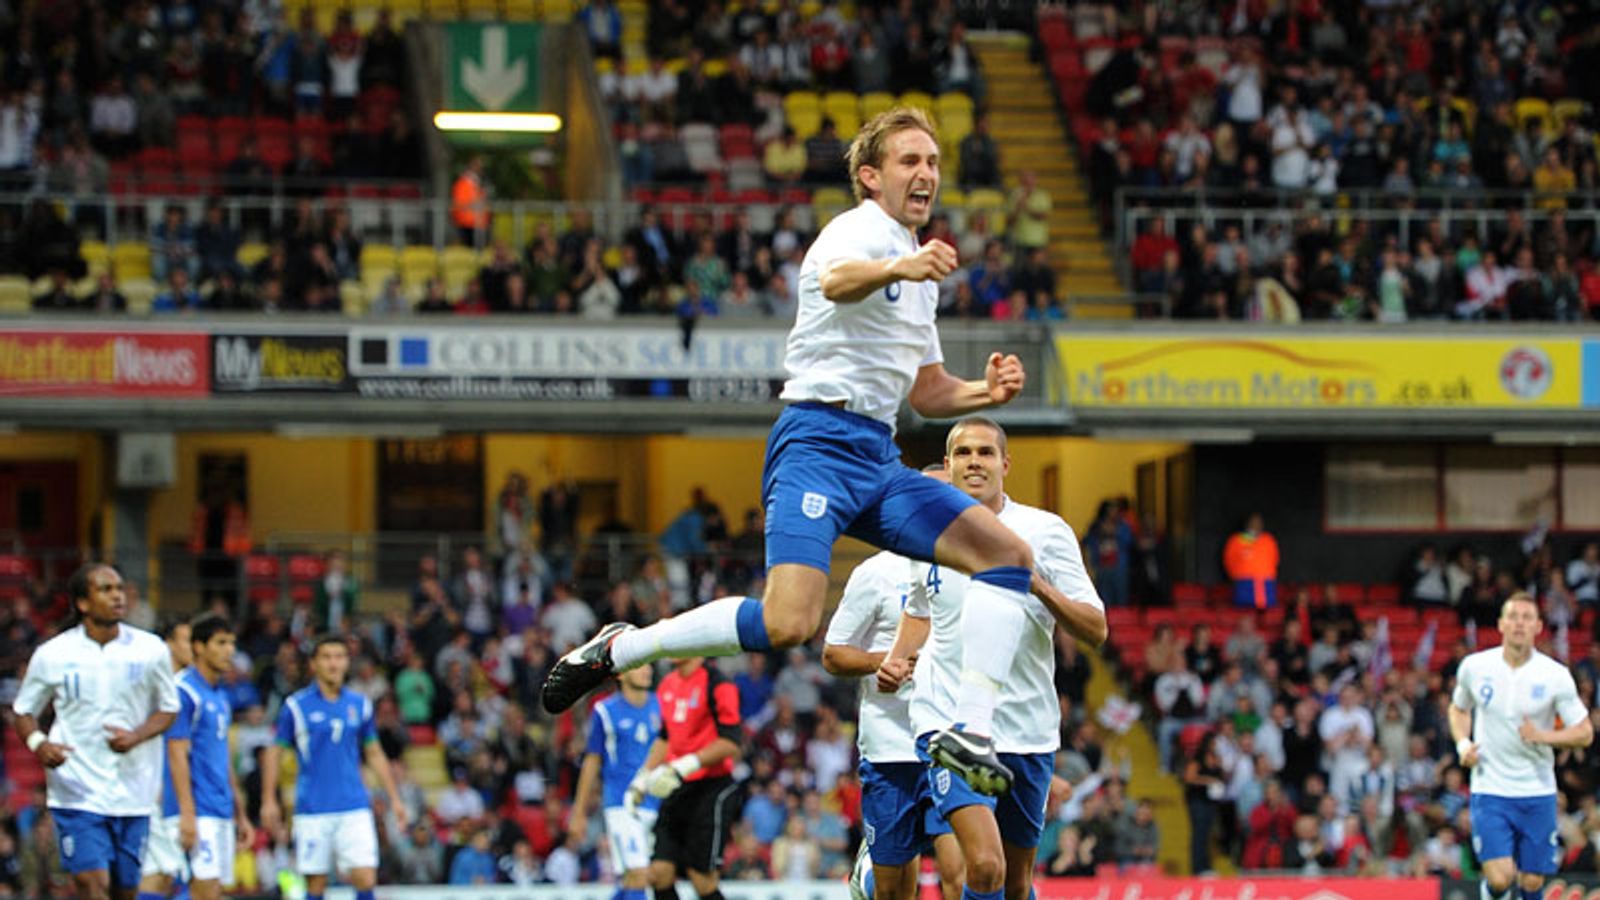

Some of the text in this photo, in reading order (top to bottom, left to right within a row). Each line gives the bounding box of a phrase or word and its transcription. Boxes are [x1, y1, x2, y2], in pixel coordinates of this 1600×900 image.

[439, 338, 628, 371] COLLINS
[1076, 366, 1377, 404] Northern Motors
[1480, 684, 1494, 709] 9
[329, 717, 344, 743] 7
